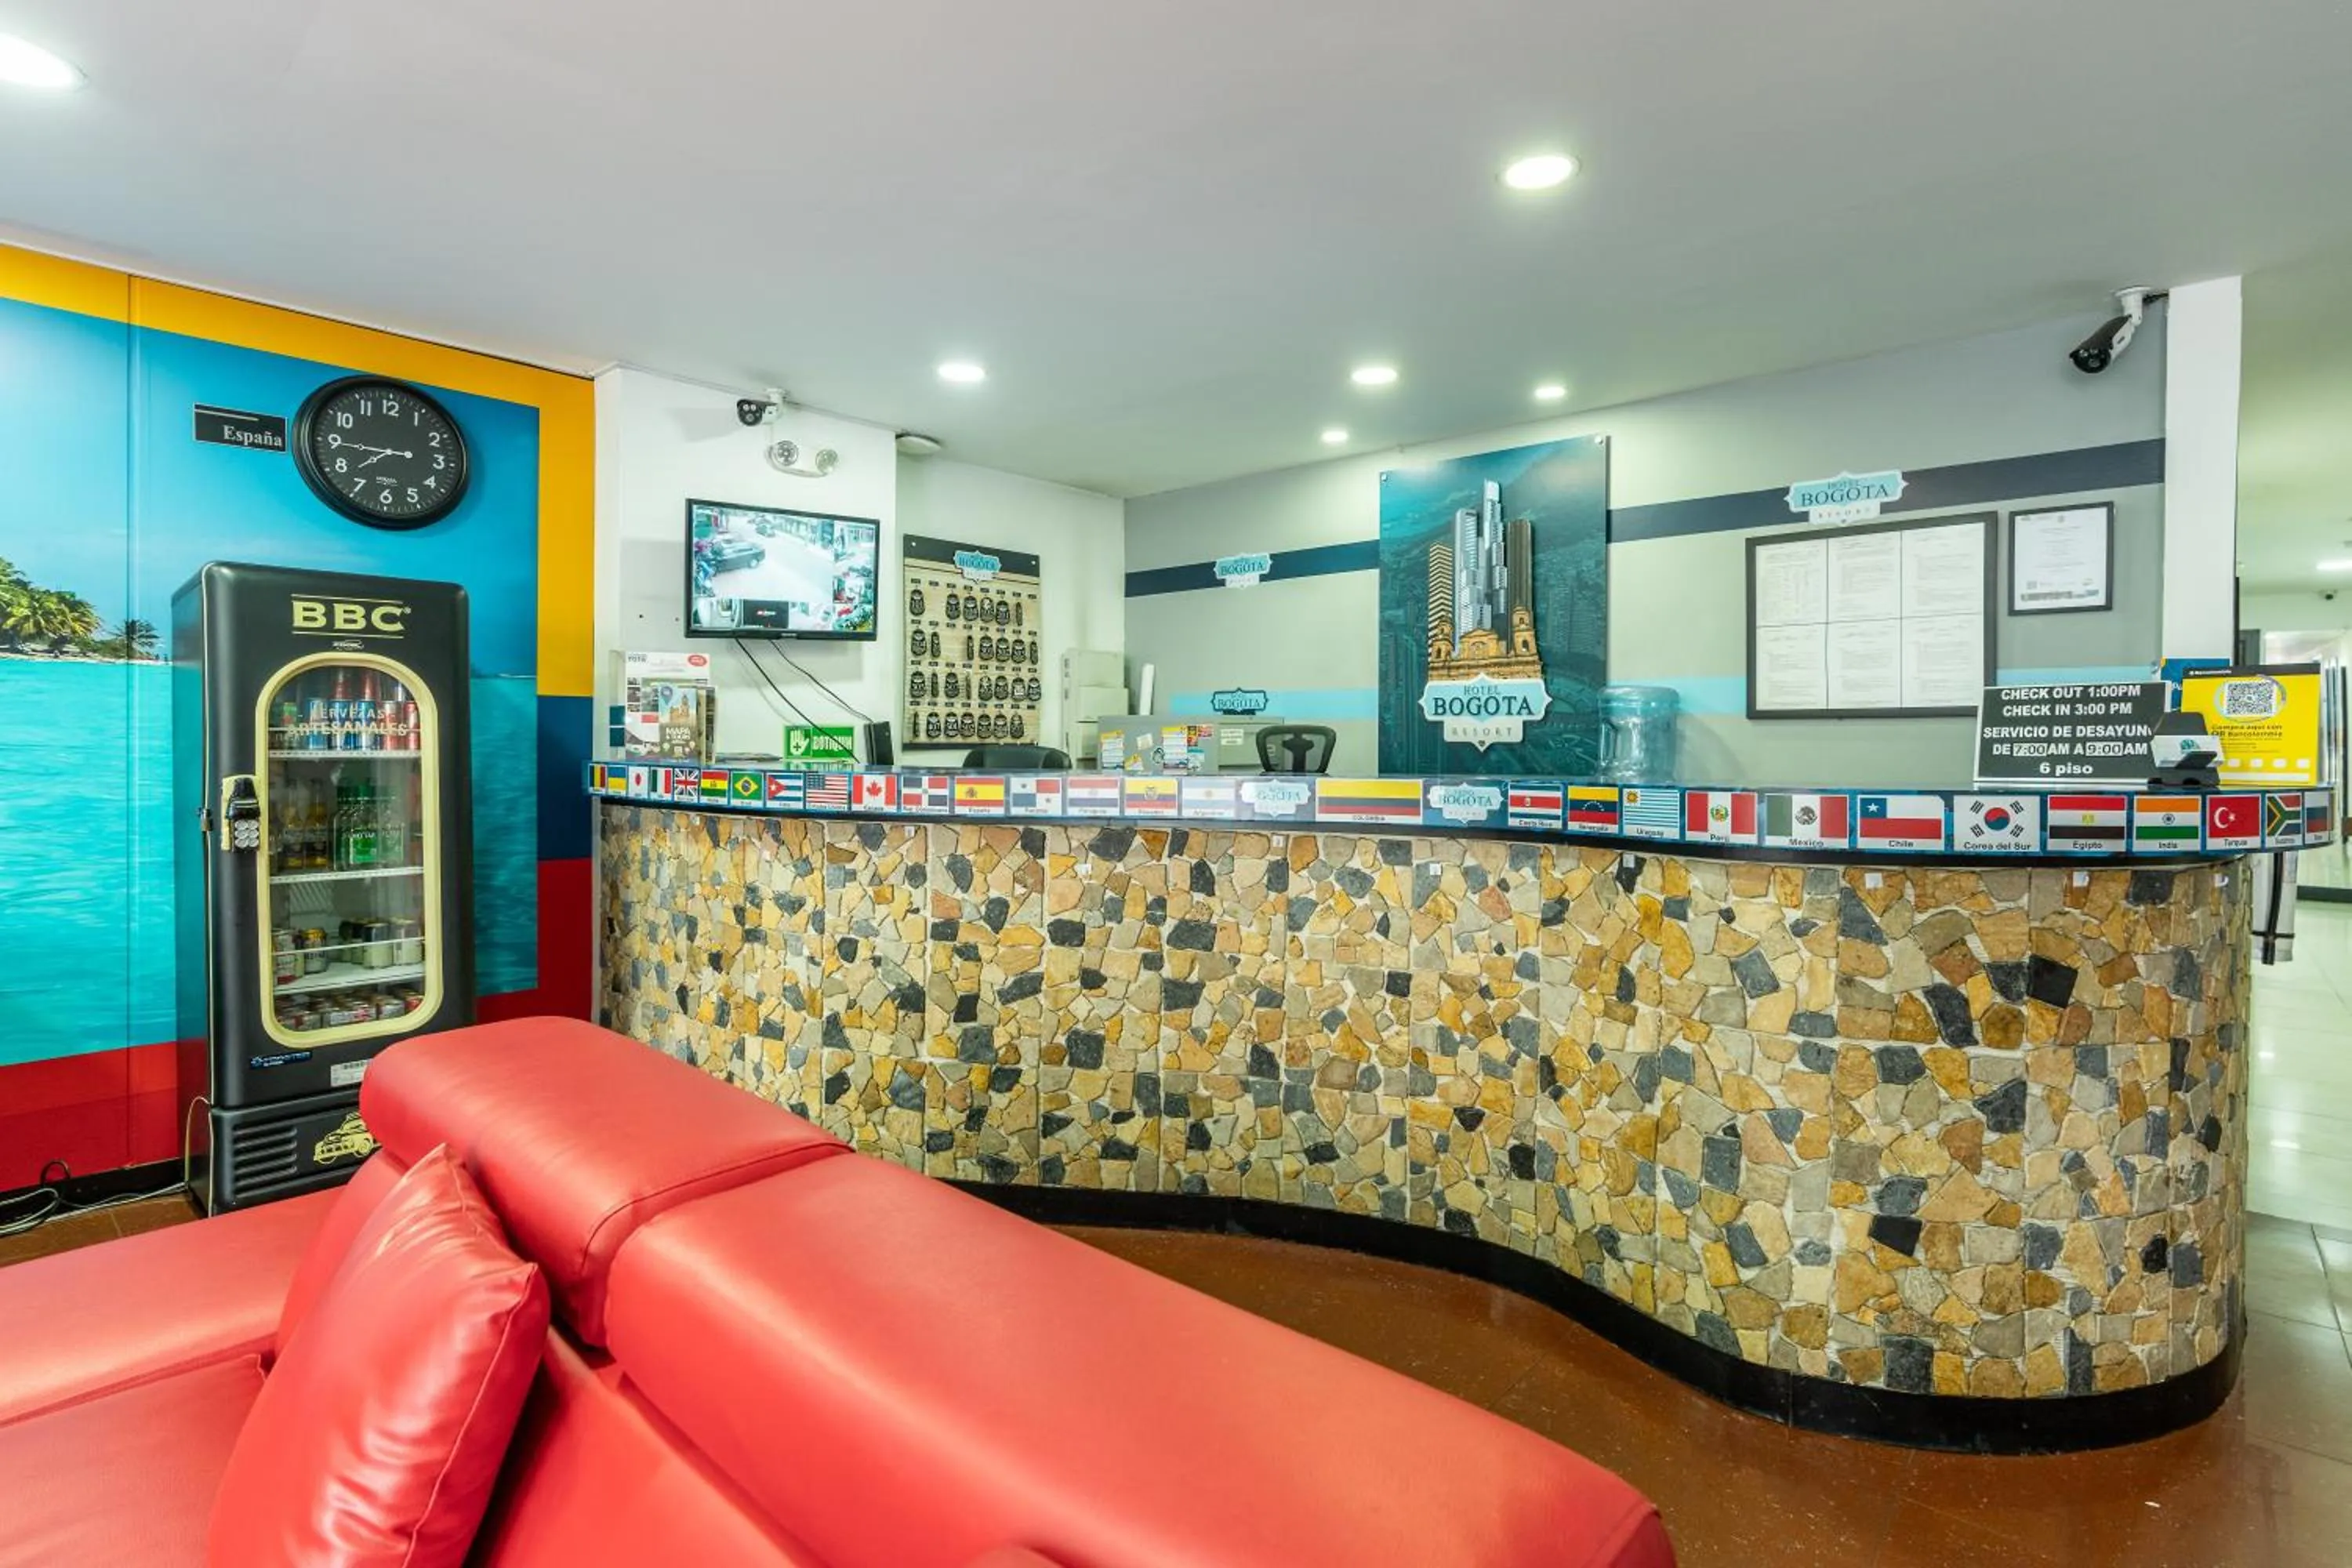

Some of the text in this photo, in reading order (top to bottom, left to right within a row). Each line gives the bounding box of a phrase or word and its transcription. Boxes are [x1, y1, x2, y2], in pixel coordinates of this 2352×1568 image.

[361, 399, 372, 416] 11
[383, 399, 399, 416] 12
[337, 412, 353, 429] 10
[413, 412, 419, 427] 1
[223, 424, 283, 447] España
[328, 434, 341, 449] 9
[429, 432, 440, 448] 2
[335, 457, 347, 473] 8
[433, 454, 445, 470] 3
[354, 477, 367, 492] 7
[423, 475, 437, 489] 4
[379, 488, 392, 504] 6
[406, 488, 418, 503] 5
[1801, 483, 1889, 507] BOGOTA
[292, 601, 405, 632] BBC
[1464, 685, 1501, 696] HOTEL
[2002, 685, 2141, 700] CHECK OUT 1:00PM
[311, 706, 386, 720] ERVEZAS
[1432, 695, 1535, 717] BOGOTA
[2003, 702, 2132, 717] CHECK IN 3:00 PM
[287, 720, 408, 737] ARTESANALES
[1452, 727, 1512, 737] RESORT
[1983, 726, 2049, 739] SERVICIO
[2053, 726, 2073, 738] DE
[1992, 743, 2010, 755] DE
[2074, 743, 2085, 755] A
[2039, 762, 2094, 776] 6 piso
[1439, 793, 1494, 807] BOGOTA
[1889, 840, 1914, 848] Chile
[1963, 841, 2031, 851] Corea del Sur
[2072, 841, 2103, 851] Egipto
[2158, 841, 2178, 850] India
